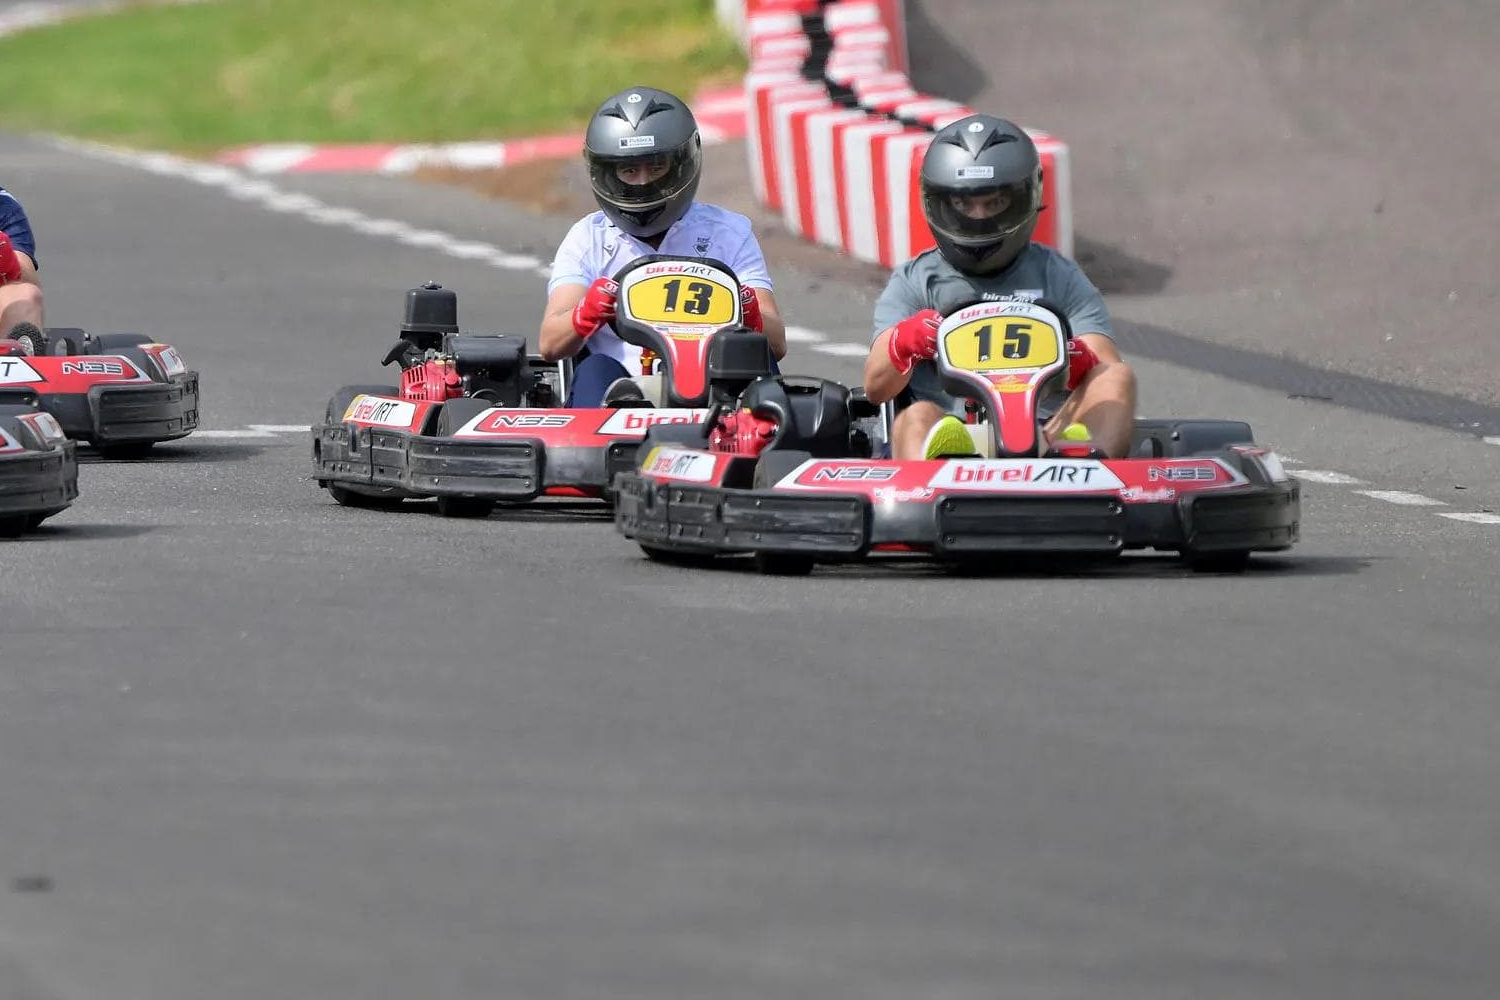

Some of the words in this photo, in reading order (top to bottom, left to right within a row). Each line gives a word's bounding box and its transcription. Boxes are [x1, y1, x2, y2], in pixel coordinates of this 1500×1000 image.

[643, 265, 714, 275] birelART
[663, 279, 714, 315] 13
[974, 323, 1033, 362] 15
[953, 463, 1100, 484] birelART
